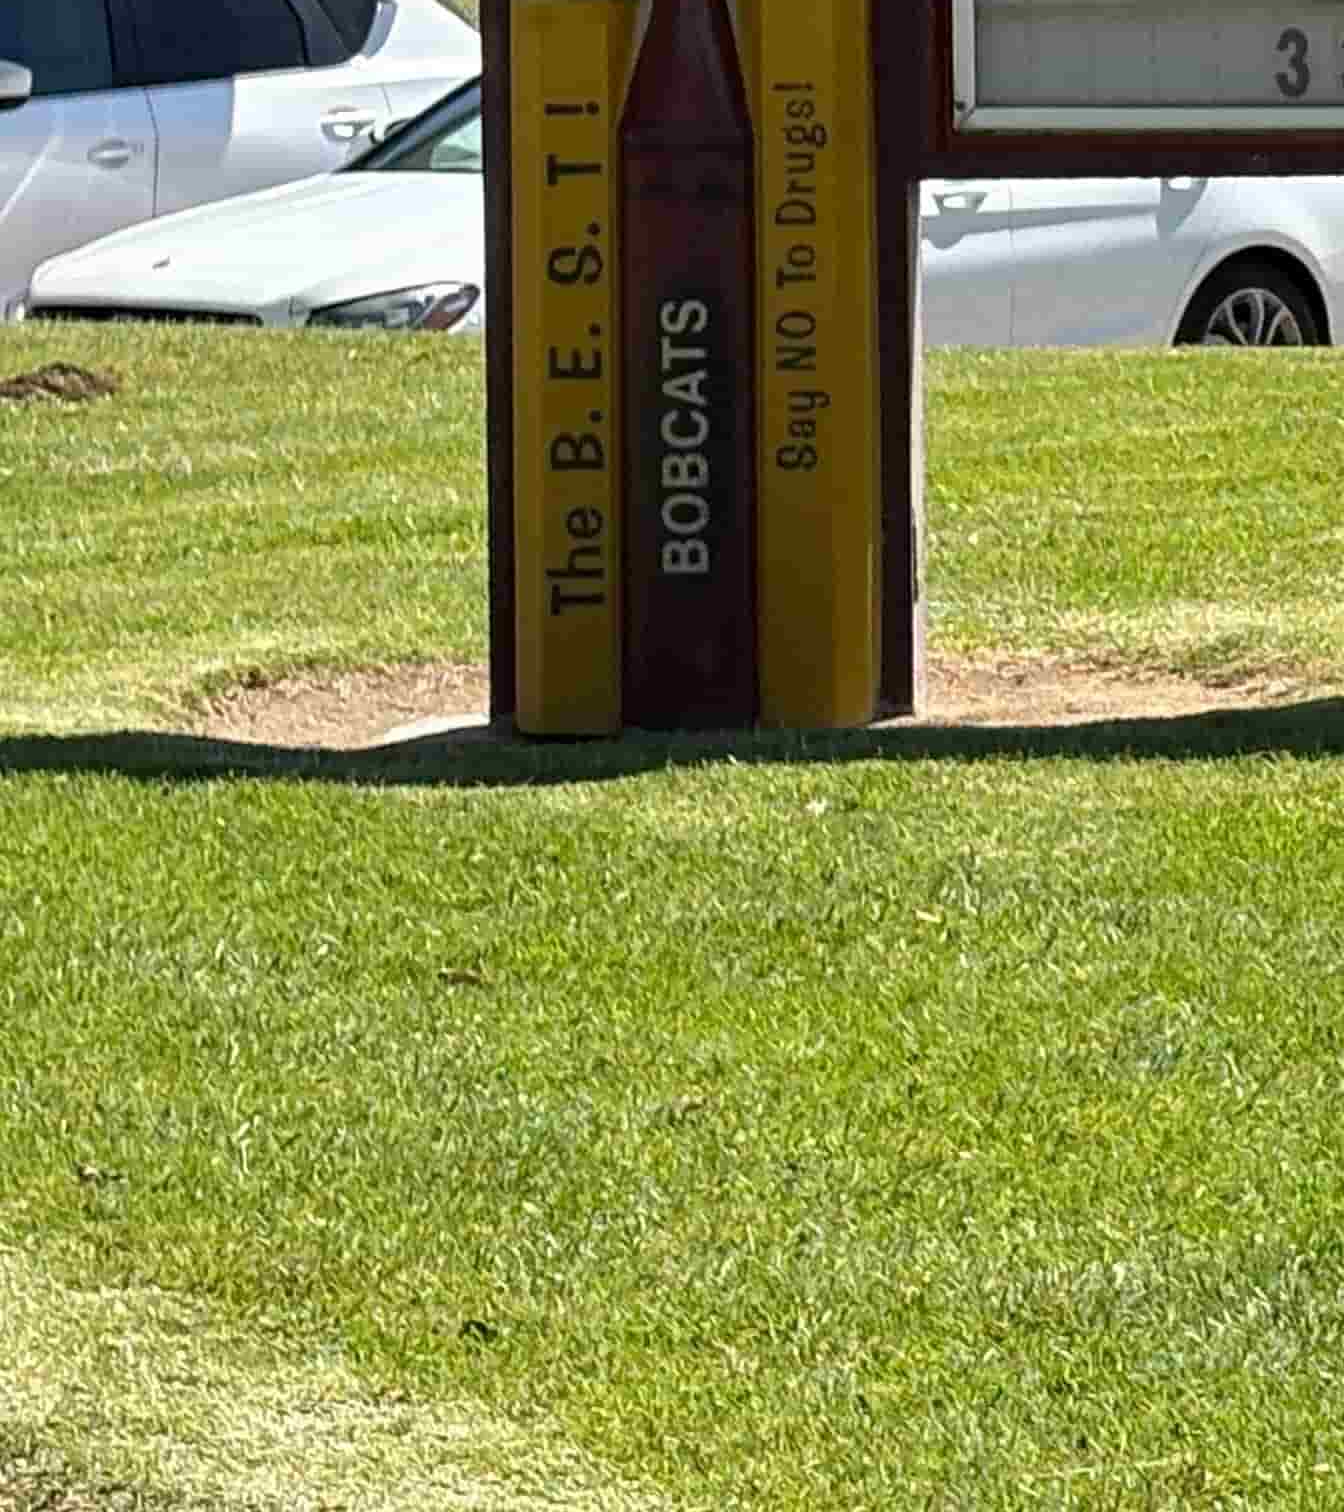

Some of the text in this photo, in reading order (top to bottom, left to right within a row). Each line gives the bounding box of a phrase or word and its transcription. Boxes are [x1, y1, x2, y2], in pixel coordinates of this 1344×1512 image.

[774, 81, 831, 473] Say NO To Drugs!
[545, 504, 606, 616] The
[659, 298, 710, 575] BOBCATS
